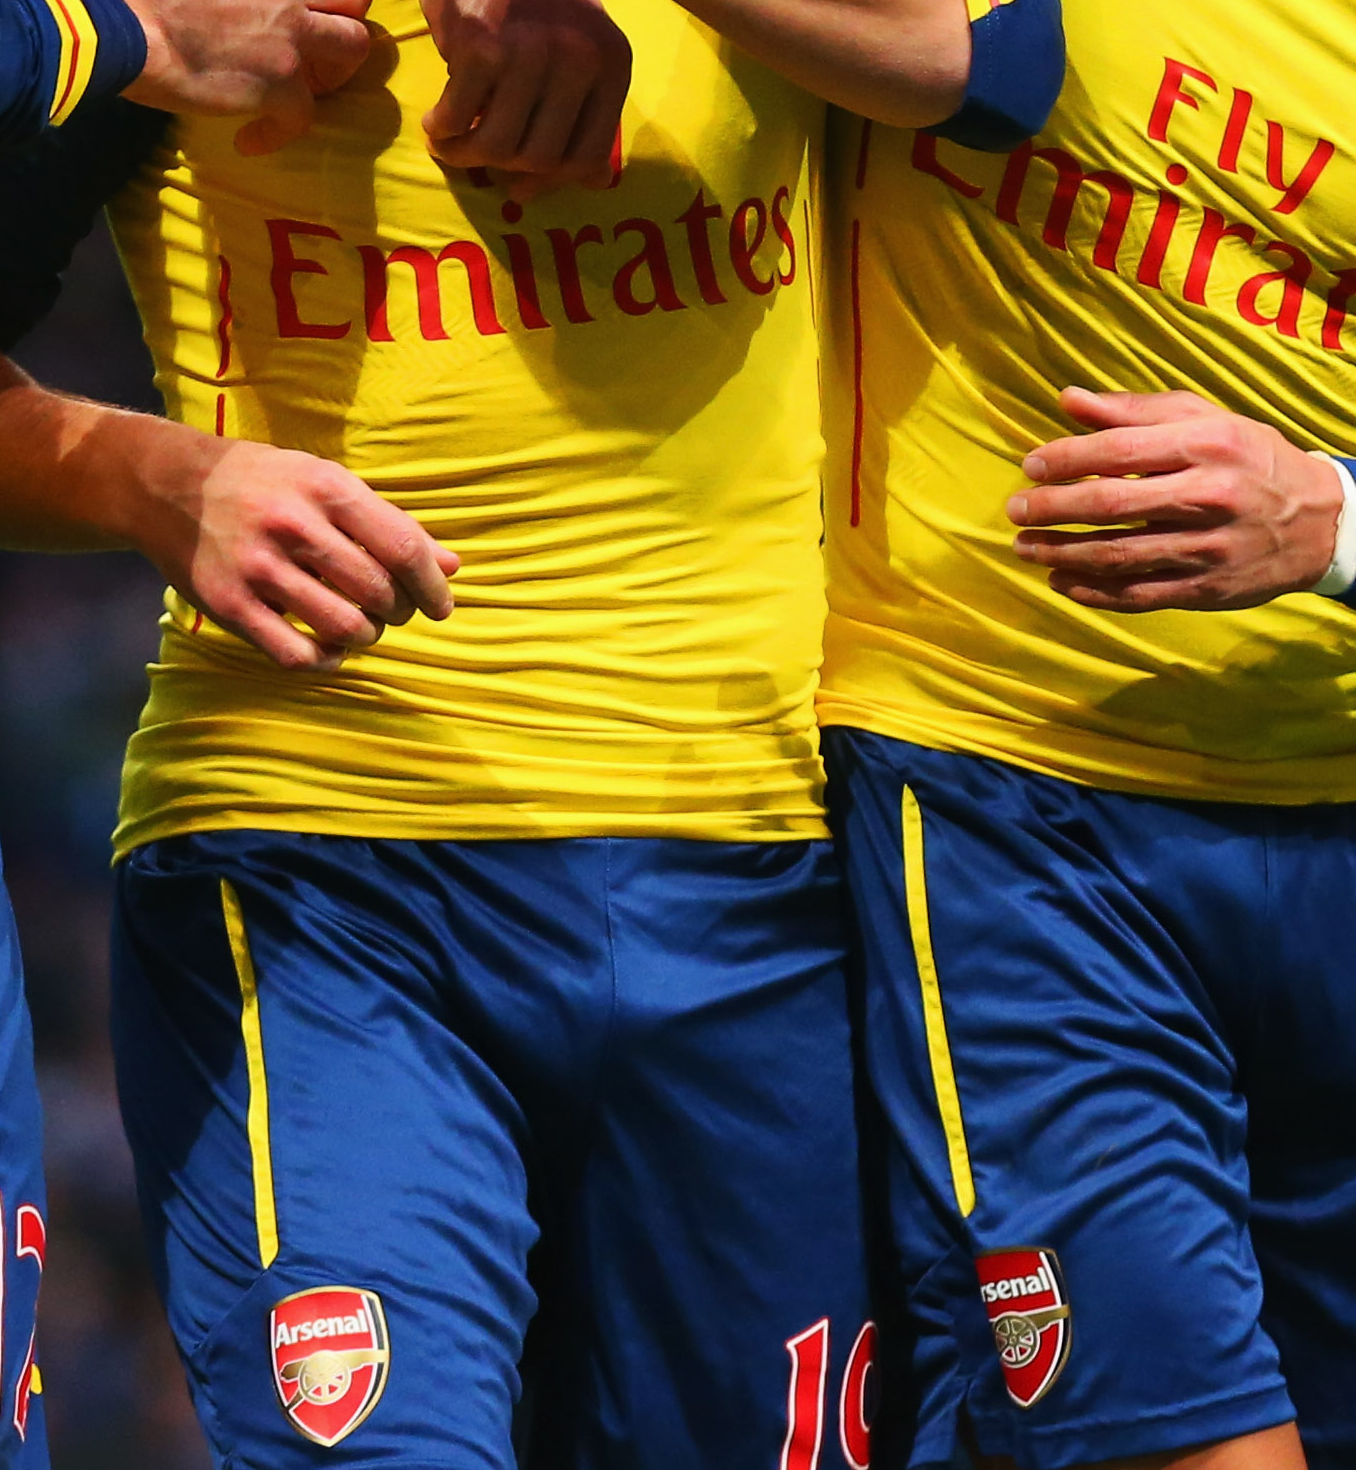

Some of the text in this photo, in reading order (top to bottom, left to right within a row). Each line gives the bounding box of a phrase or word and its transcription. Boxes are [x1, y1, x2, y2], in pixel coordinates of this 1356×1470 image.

[1146, 56, 1336, 216] Fly
[265, 185, 796, 343] Emirates
[274, 1309, 369, 1349] Arsenal
[980, 1266, 1051, 1303] rsenal
